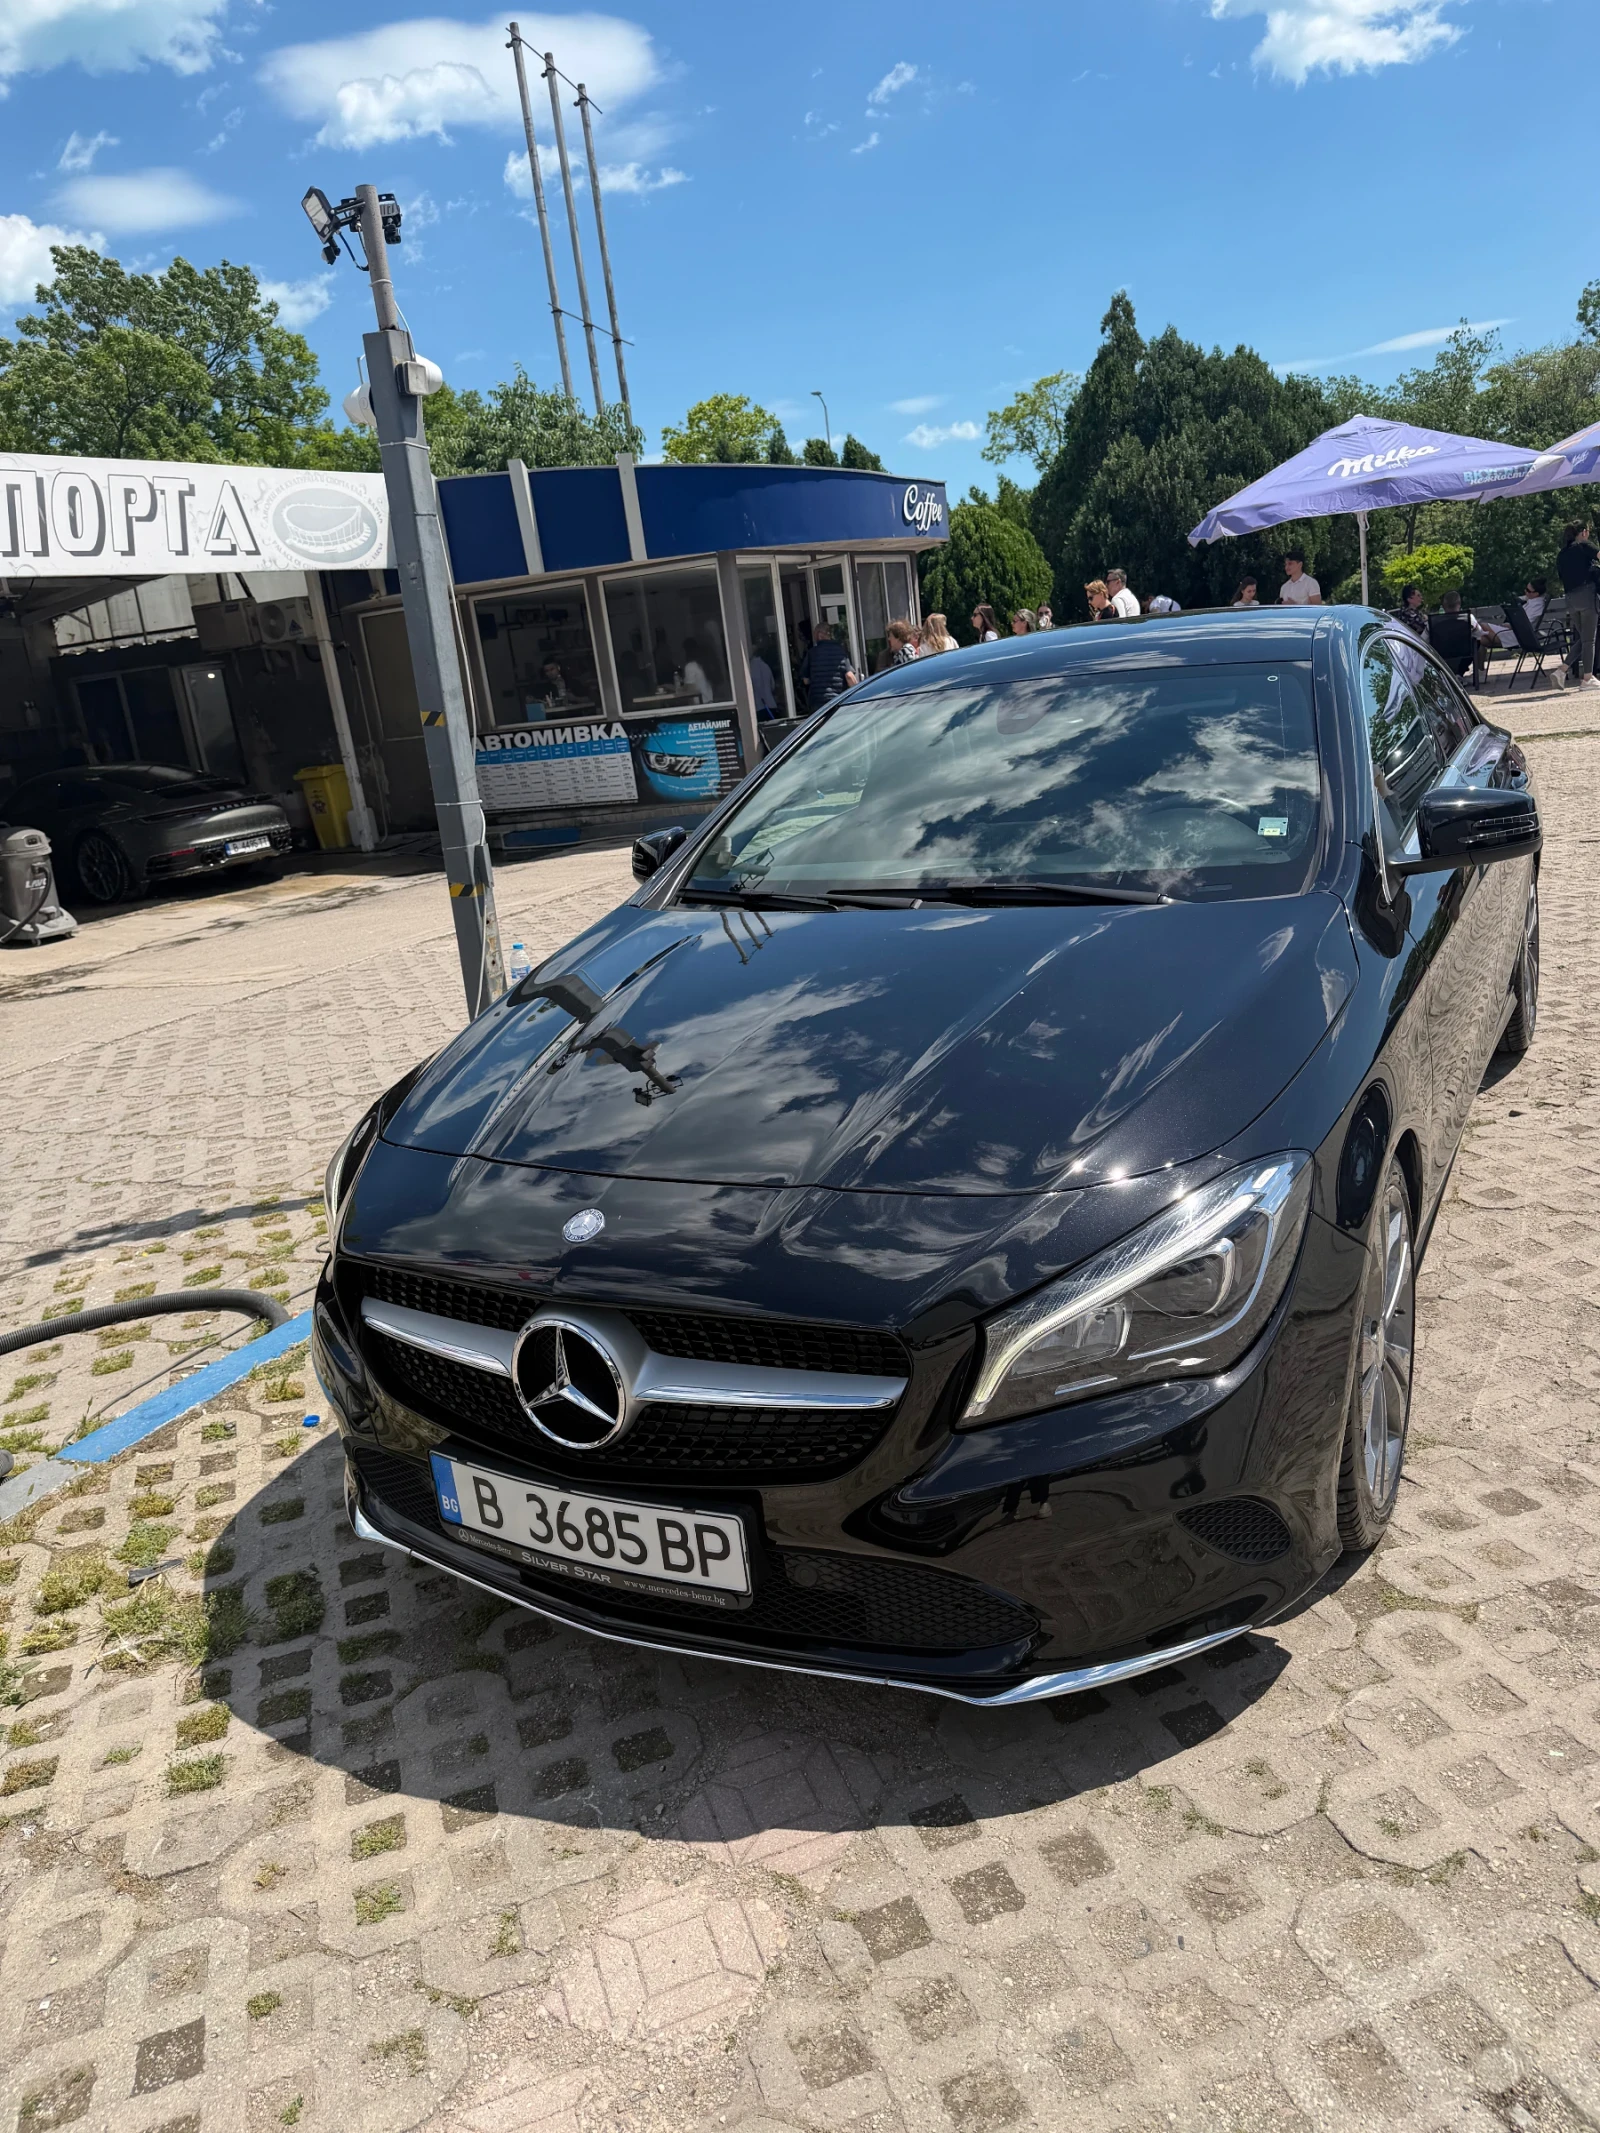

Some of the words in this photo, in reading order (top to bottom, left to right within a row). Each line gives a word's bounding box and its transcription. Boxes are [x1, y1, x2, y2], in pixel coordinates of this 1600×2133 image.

[1327, 446, 1441, 477] Milka
[904, 484, 943, 531] Coffee
[472, 722, 628, 752] АВТОМИВКА
[687, 719, 731, 732] ДЕТАЙЛИНГ
[441, 1495, 459, 1514] BG
[472, 1475, 504, 1530] B
[525, 1493, 648, 1566] 3685
[656, 1517, 731, 1578] BP
[470, 1534, 512, 1556] Mercedes-Benz
[623, 1580, 726, 1606] www.mercedes-benz.bg
